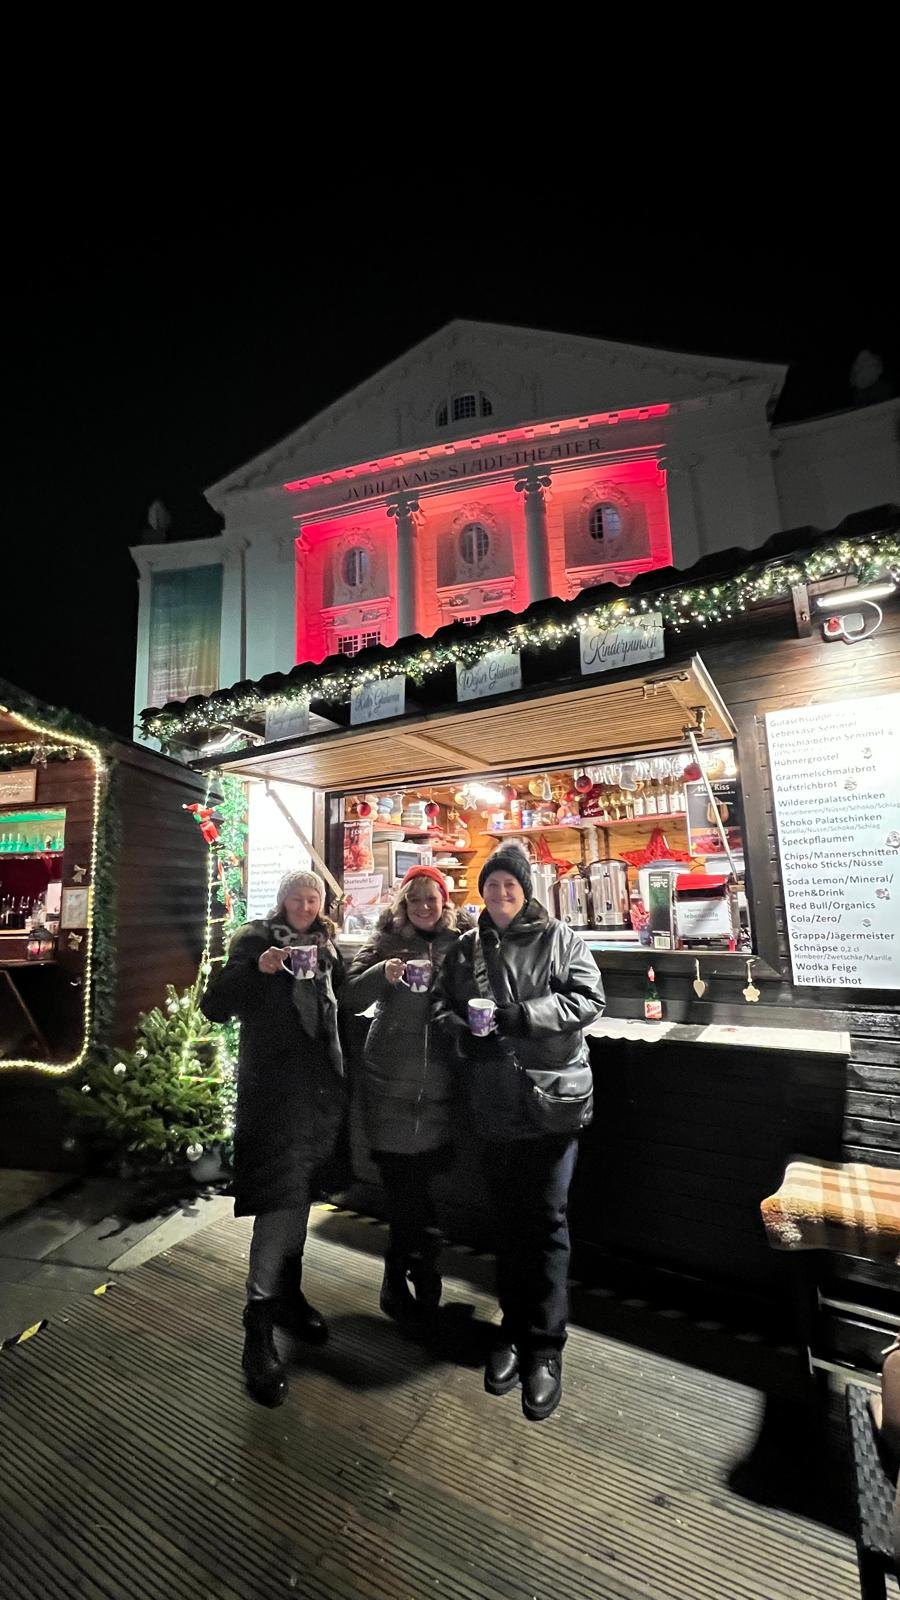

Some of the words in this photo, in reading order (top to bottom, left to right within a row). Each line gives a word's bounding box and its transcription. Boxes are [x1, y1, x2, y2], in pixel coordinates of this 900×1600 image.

[583, 632, 657, 665] Kinderpunsch
[775, 764, 877, 781] Grammelschmalzbrot
[777, 780, 838, 793] Aufstrichbrot
[778, 791, 886, 807] Wildererpalatschinken
[780, 818, 813, 828] Schoko
[815, 813, 882, 825] Palatschinken
[782, 835, 854, 847] Speckpflaumen
[784, 849, 898, 861] Chips/Mannerschnitten
[785, 862, 818, 871] Schoko
[820, 859, 883, 869] Sticks/Nüsse
[787, 877, 810, 886] Soda
[812, 874, 894, 885] Lemon/Mineral/
[788, 889, 845, 898] Dreh&Drink
[789, 902, 807, 910] Red
[810, 900, 876, 911] Bull/Organics
[790, 914, 842, 923] Cola/Zero/
[792, 930, 895, 941] Grappa/Jägermeister
[794, 943, 838, 953] Schnäpse
[796, 963, 829, 971] Wodka
[832, 963, 857, 973] Feige
[797, 975, 837, 983] Eierlikör
[839, 976, 862, 985] Shot
